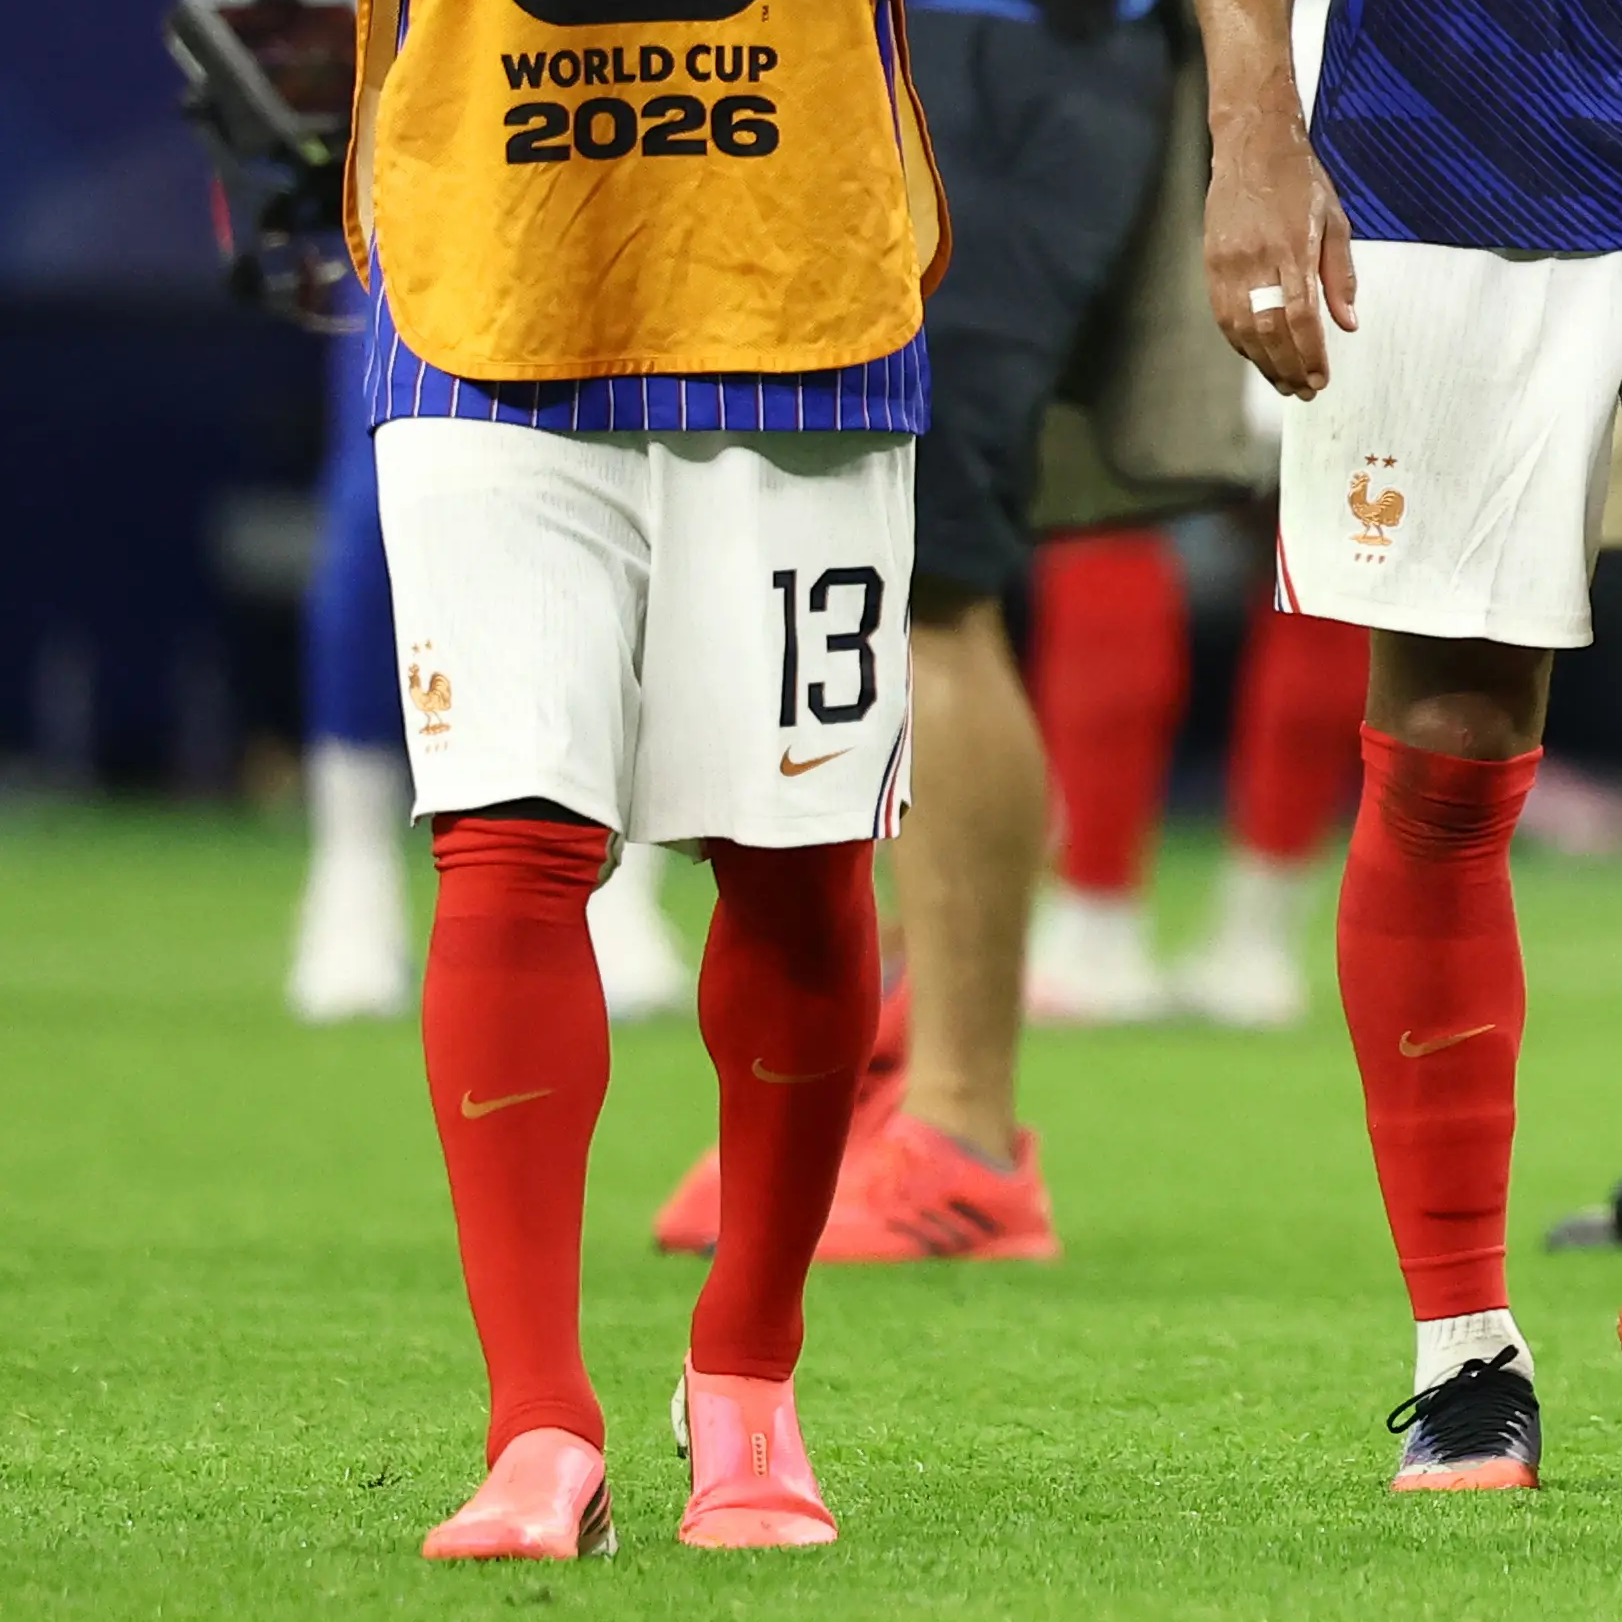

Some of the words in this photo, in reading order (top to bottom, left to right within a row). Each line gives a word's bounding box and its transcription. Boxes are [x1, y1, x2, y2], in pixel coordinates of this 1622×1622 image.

[501, 46, 675, 90] WORLD
[685, 44, 778, 83] CUP
[503, 94, 780, 164] 2026
[773, 566, 885, 727] 13
